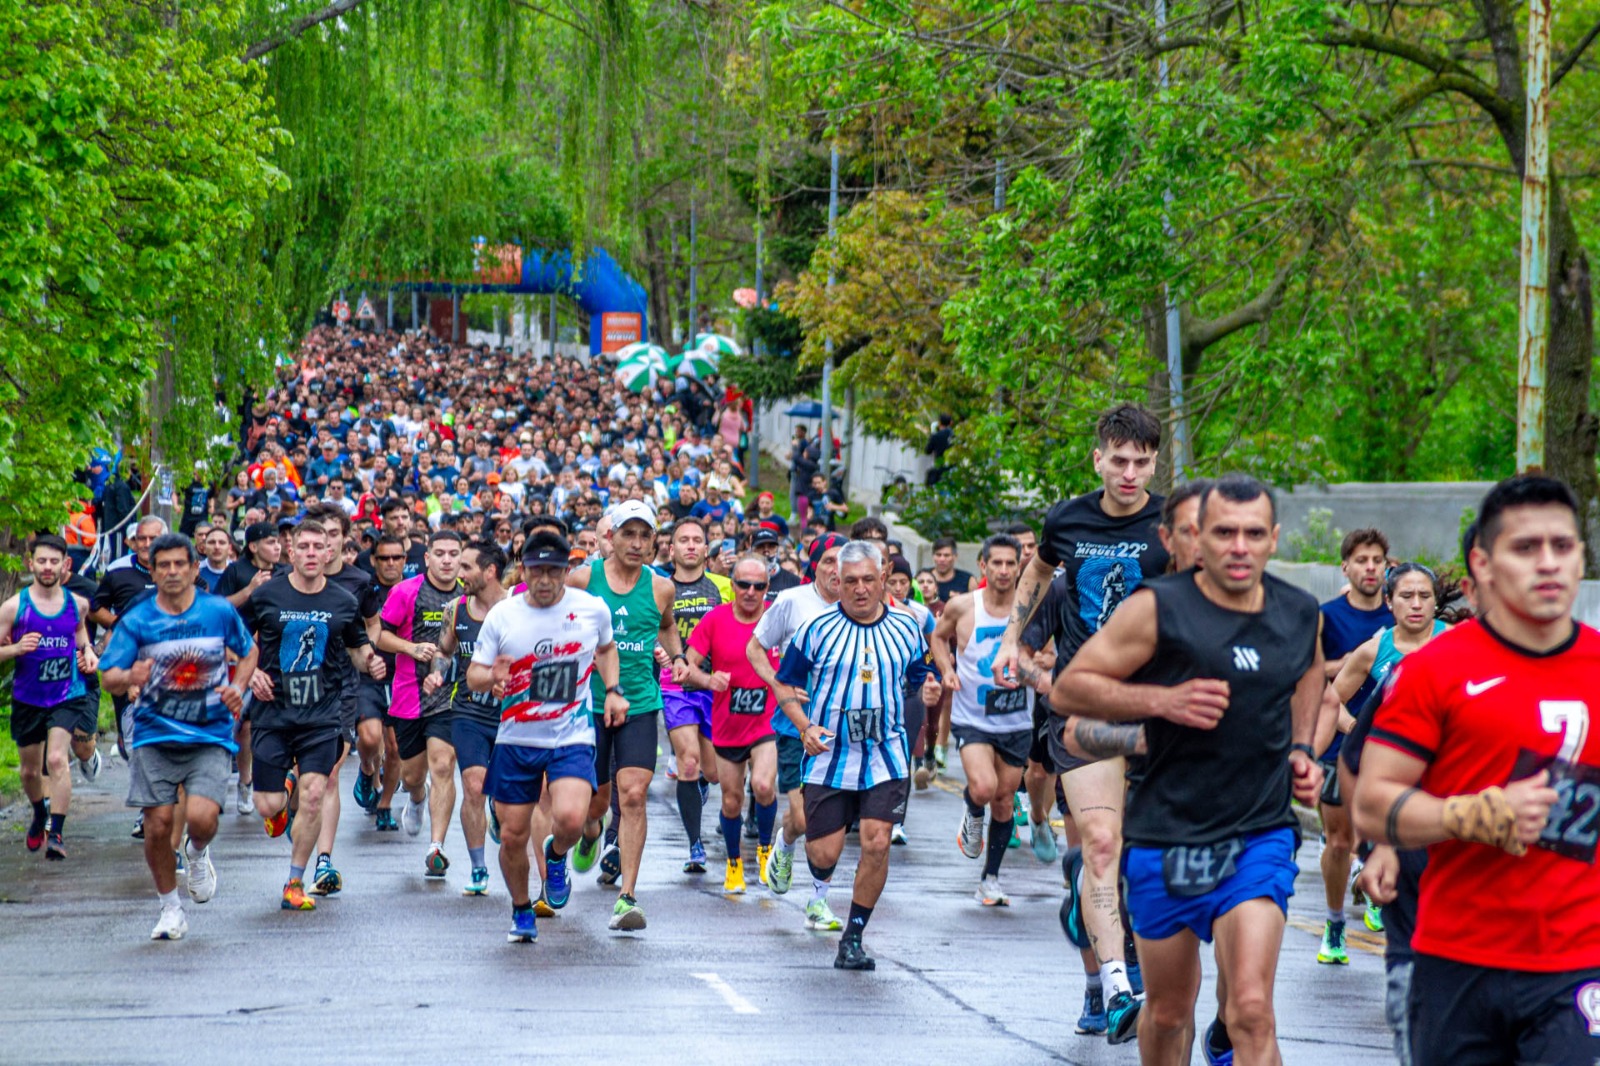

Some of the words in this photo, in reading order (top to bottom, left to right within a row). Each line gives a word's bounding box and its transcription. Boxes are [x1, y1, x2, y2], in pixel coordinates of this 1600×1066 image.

[1075, 548, 1116, 556] MIGUEL
[39, 657, 70, 681] 142
[536, 665, 571, 700] 671
[289, 674, 319, 705] 671
[731, 688, 764, 711] 142
[847, 708, 883, 743] 671
[1539, 700, 1589, 764] 7
[1540, 768, 1600, 846] 42
